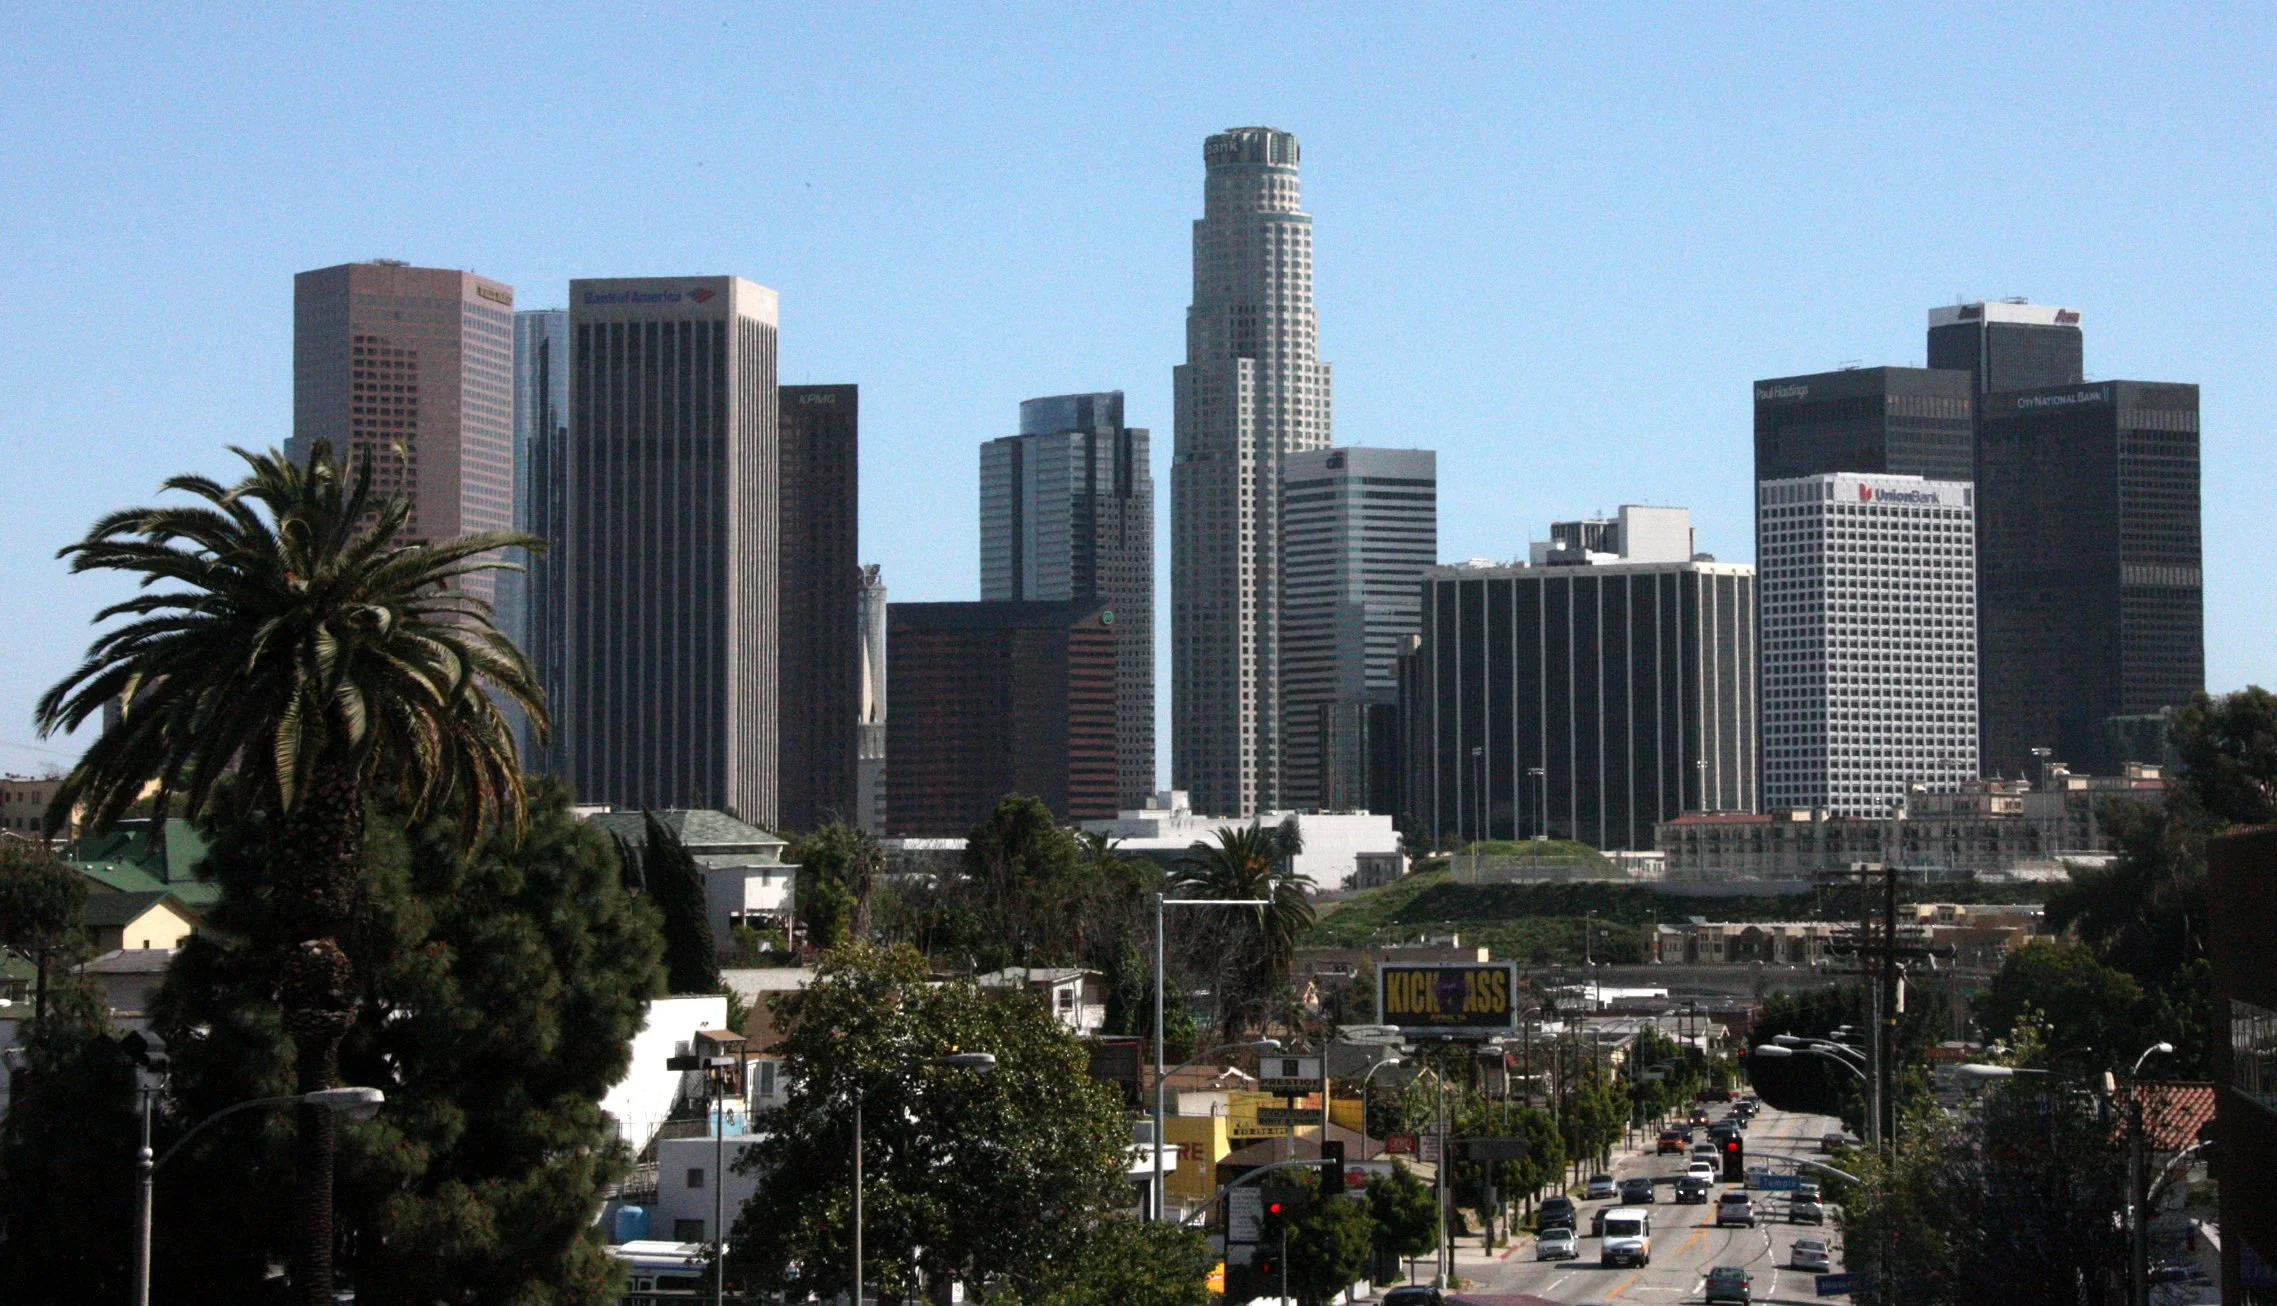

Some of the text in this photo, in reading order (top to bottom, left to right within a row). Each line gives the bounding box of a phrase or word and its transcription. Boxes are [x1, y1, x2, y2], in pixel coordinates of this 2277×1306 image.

[584, 290, 682, 304] Bank of America
[799, 394, 836, 405] KPMG
[1875, 488, 1941, 503] UnionBank
[1387, 970, 1506, 1013] KICK ASS
[1763, 1177, 1798, 1189] Temple
